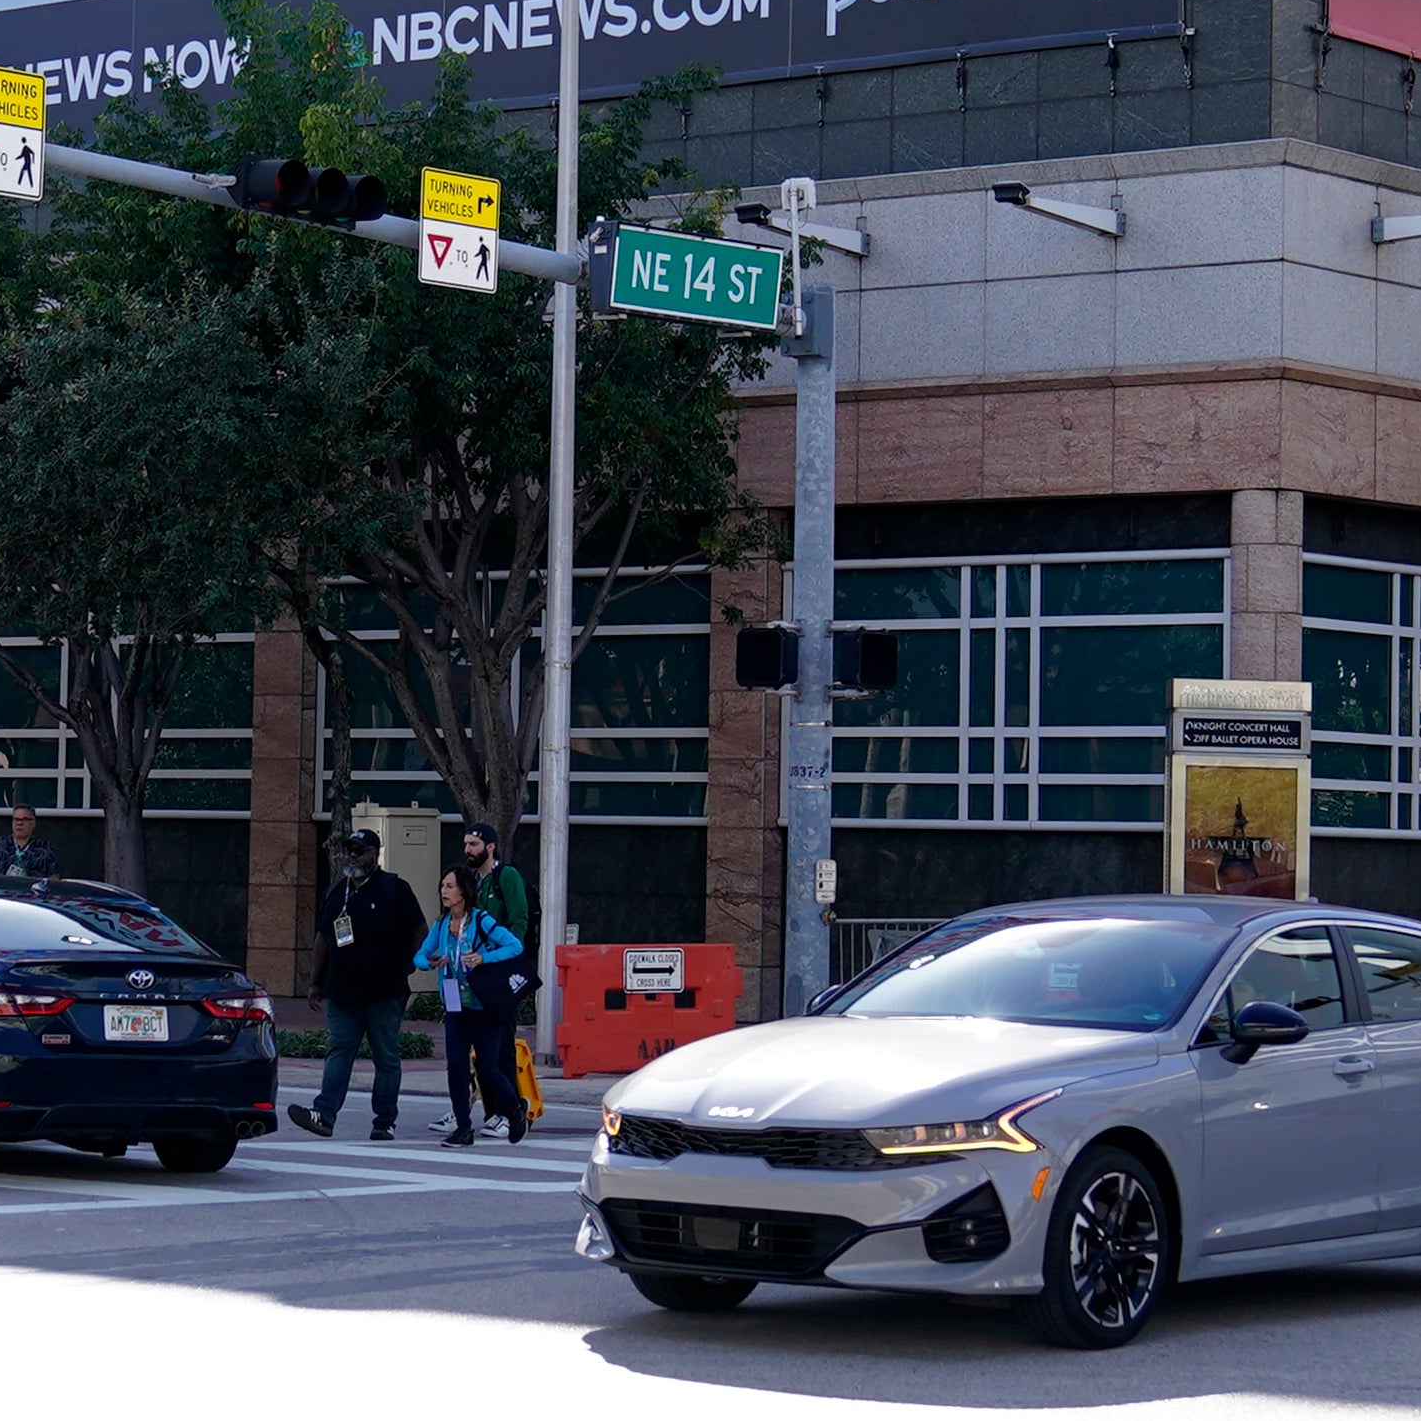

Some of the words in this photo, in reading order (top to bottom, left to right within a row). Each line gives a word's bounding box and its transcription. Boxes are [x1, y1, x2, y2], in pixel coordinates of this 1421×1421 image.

[25, 50, 134, 106] EWS
[430, 179, 473, 199] TURNING
[427, 198, 474, 218] VEHICLES
[456, 249, 468, 263] TO
[631, 249, 671, 292] NE
[684, 253, 716, 302] 14
[728, 264, 763, 305] ST
[1193, 722, 1227, 731] KNIGHT
[1227, 722, 1268, 732] CONCERT
[1270, 724, 1290, 733] HALL
[1193, 734, 1209, 743] ZIFF
[1211, 735, 1238, 744] BALLET
[1239, 736, 1268, 745] OPERA
[1269, 736, 1299, 746] HOUSE
[1191, 838, 1286, 852] HAMILTON
[629, 954, 657, 964] SIDEWALK
[658, 954, 679, 964] CLOSED
[636, 978, 655, 987] CROSS
[657, 978, 671, 987] HERE
